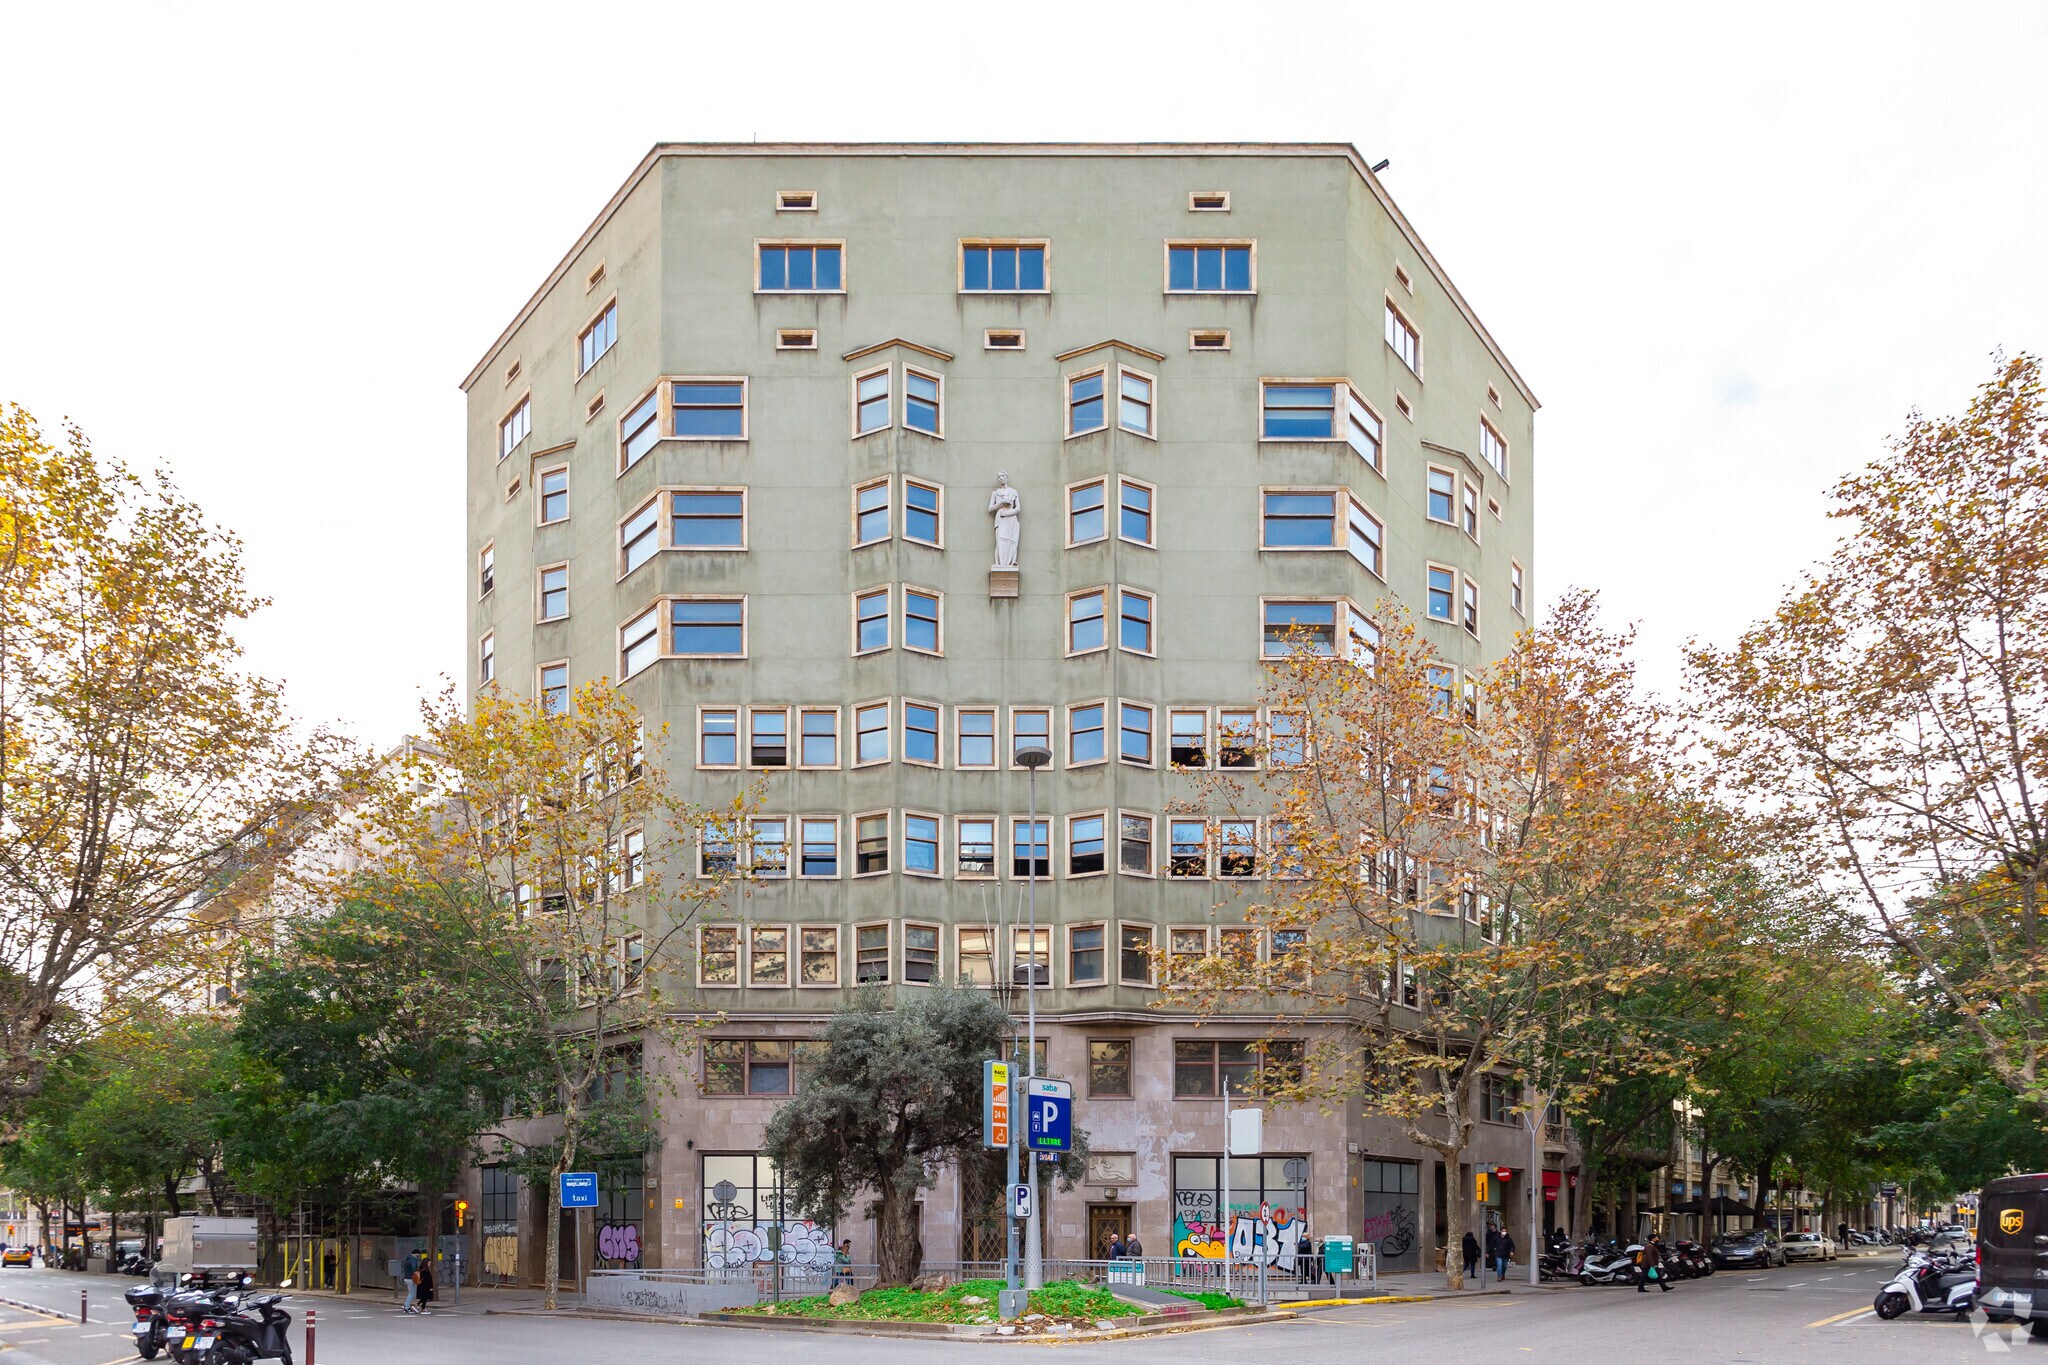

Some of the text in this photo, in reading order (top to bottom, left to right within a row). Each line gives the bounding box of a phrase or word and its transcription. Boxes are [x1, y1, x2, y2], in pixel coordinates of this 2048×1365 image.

[1041, 1083, 1058, 1093] saba
[994, 1110, 1001, 1119] 24
[1042, 1101, 1059, 1133] P
[1017, 1187, 1028, 1206] P
[2001, 1216, 2022, 1231] ups
